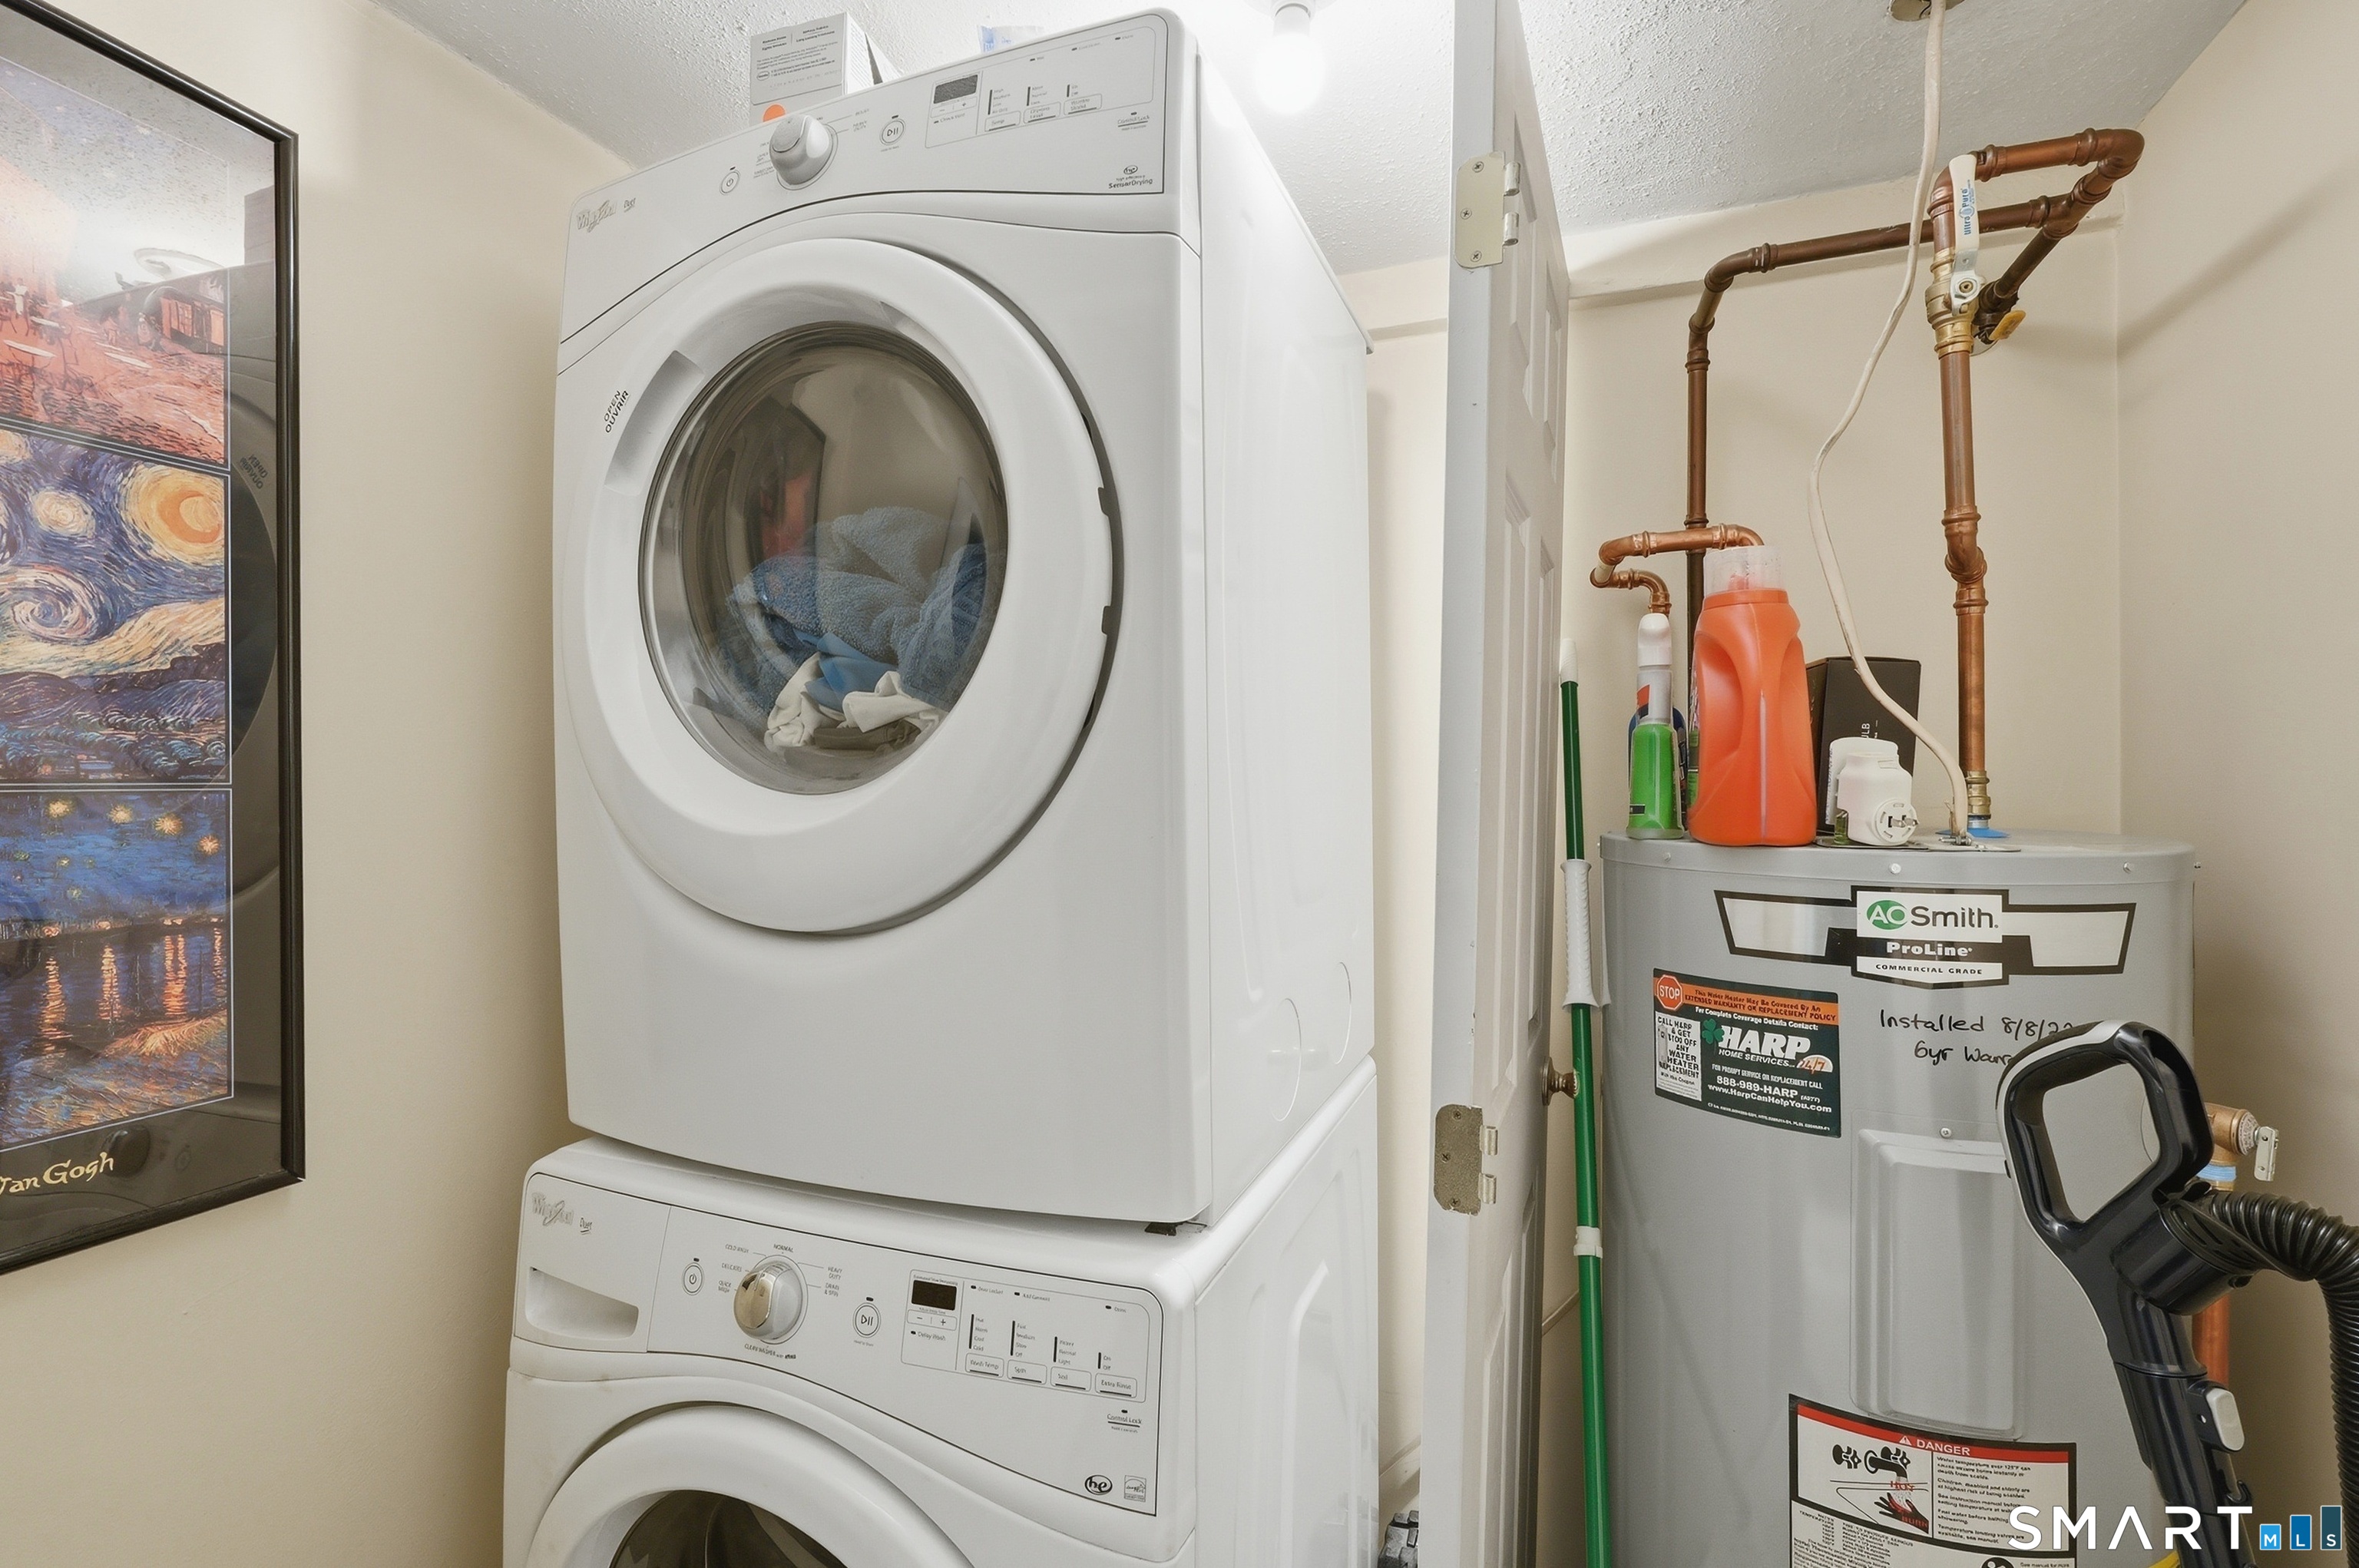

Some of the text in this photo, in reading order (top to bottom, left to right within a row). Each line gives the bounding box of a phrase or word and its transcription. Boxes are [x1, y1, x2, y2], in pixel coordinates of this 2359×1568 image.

[604, 390, 620, 422] OPEN
[605, 391, 628, 432] OUVRIR
[1887, 941, 1968, 956] ProLine
[1876, 964, 1943, 973] COMMERCIAL
[1659, 984, 1680, 1000] STOP
[1713, 1000, 1746, 1011] WARRANTY
[1758, 1006, 1808, 1018] REPLACEMENT
[1809, 1012, 1836, 1021] POLICY
[1771, 1001, 1798, 1011] Covered
[1658, 1017, 1673, 1027] CALL
[1705, 1008, 1732, 1017] Complete
[1732, 1013, 1762, 1024] Coverage
[1880, 1009, 1984, 1031] Installed
[1677, 1029, 1691, 1037] GET
[1676, 1044, 1689, 1053] ANY
[1684, 1037, 1697, 1047] OFF
[1719, 1025, 1811, 1060] HARP
[1669, 1049, 1696, 1062] WATER
[1719, 1049, 1789, 1067] HOME SERVICES
[1914, 1040, 2011, 1066] 6yr Warr
[1659, 1061, 1699, 1079] REPLACEMENT
[1667, 1056, 1699, 1071] HEATER
[1741, 1069, 1762, 1080] SERVICE
[1771, 1074, 1808, 1087] REPLACEMENT
[1808, 1080, 1823, 1090] CALL
[1707, 1084, 1832, 1113] www.HarpCanHelpYou.com
[42, 1152, 114, 1184] Gogh
[1917, 1439, 1970, 1456] DANGER
